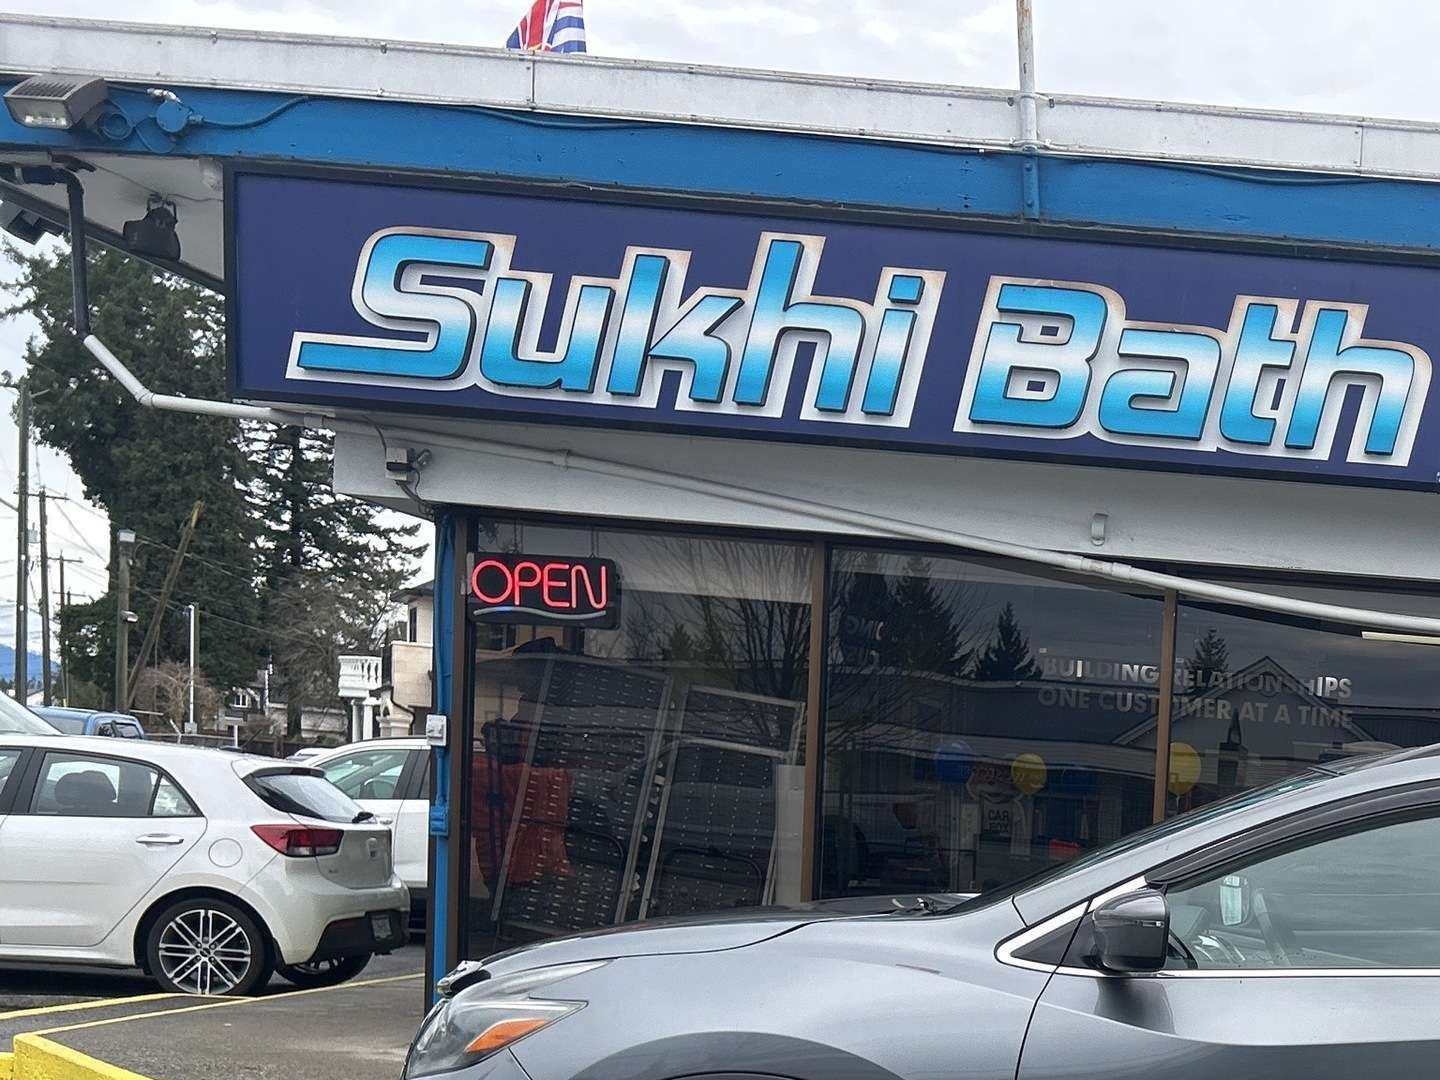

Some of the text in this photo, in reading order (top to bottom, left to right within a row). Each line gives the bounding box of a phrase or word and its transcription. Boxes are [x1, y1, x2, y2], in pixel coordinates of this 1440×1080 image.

[285, 226, 947, 428] Sukhi
[953, 275, 1432, 466] Bath
[471, 559, 607, 609] OPEN
[1042, 658, 1159, 684] BUILDING
[1039, 688, 1090, 709] ONE
[1239, 702, 1268, 722] AT
[1274, 704, 1291, 724] A
[1298, 706, 1353, 728] TIME
